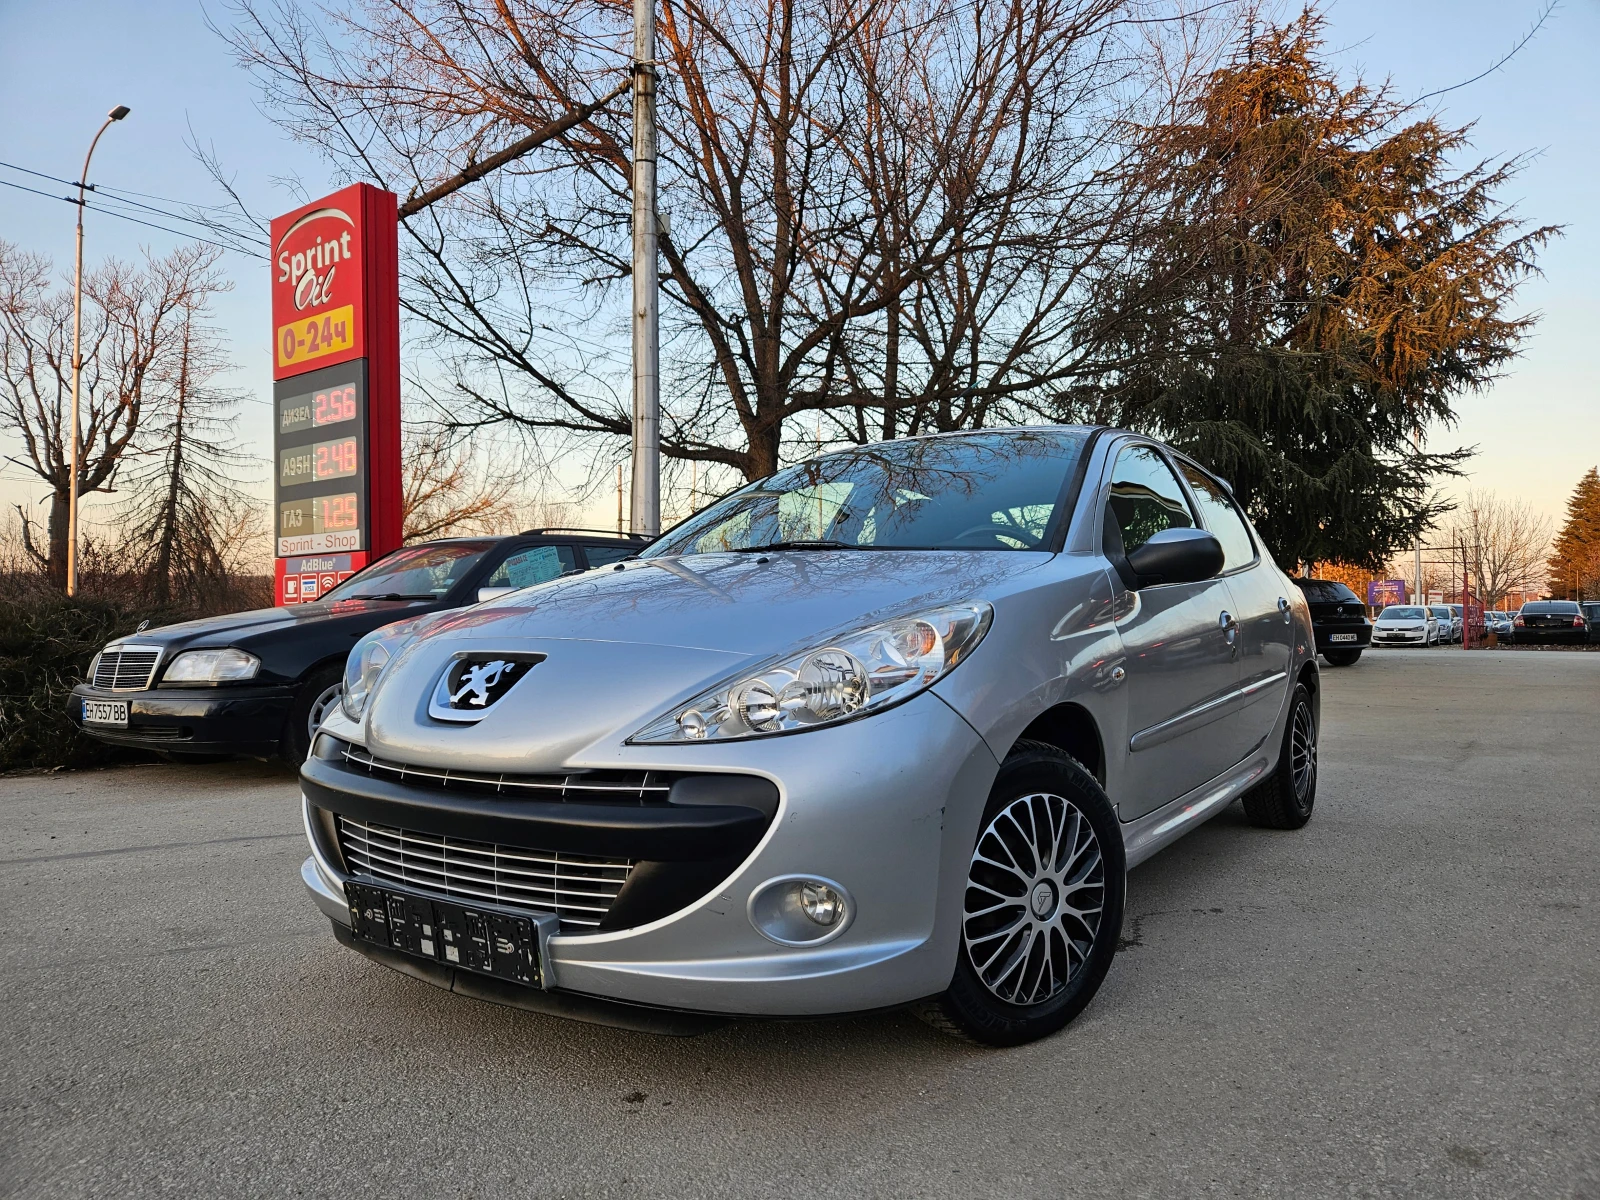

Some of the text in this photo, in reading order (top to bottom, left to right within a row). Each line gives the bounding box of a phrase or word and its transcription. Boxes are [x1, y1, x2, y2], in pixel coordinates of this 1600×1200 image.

[278, 230, 351, 286] Sprint
[294, 264, 336, 311] Oil
[282, 387, 356, 427] ДИЗЕЛ 2.56
[317, 441, 356, 477] 2.48
[283, 496, 357, 528] ГАЗ 1.25
[281, 537, 313, 555] Sprint
[325, 534, 357, 549] Shop
